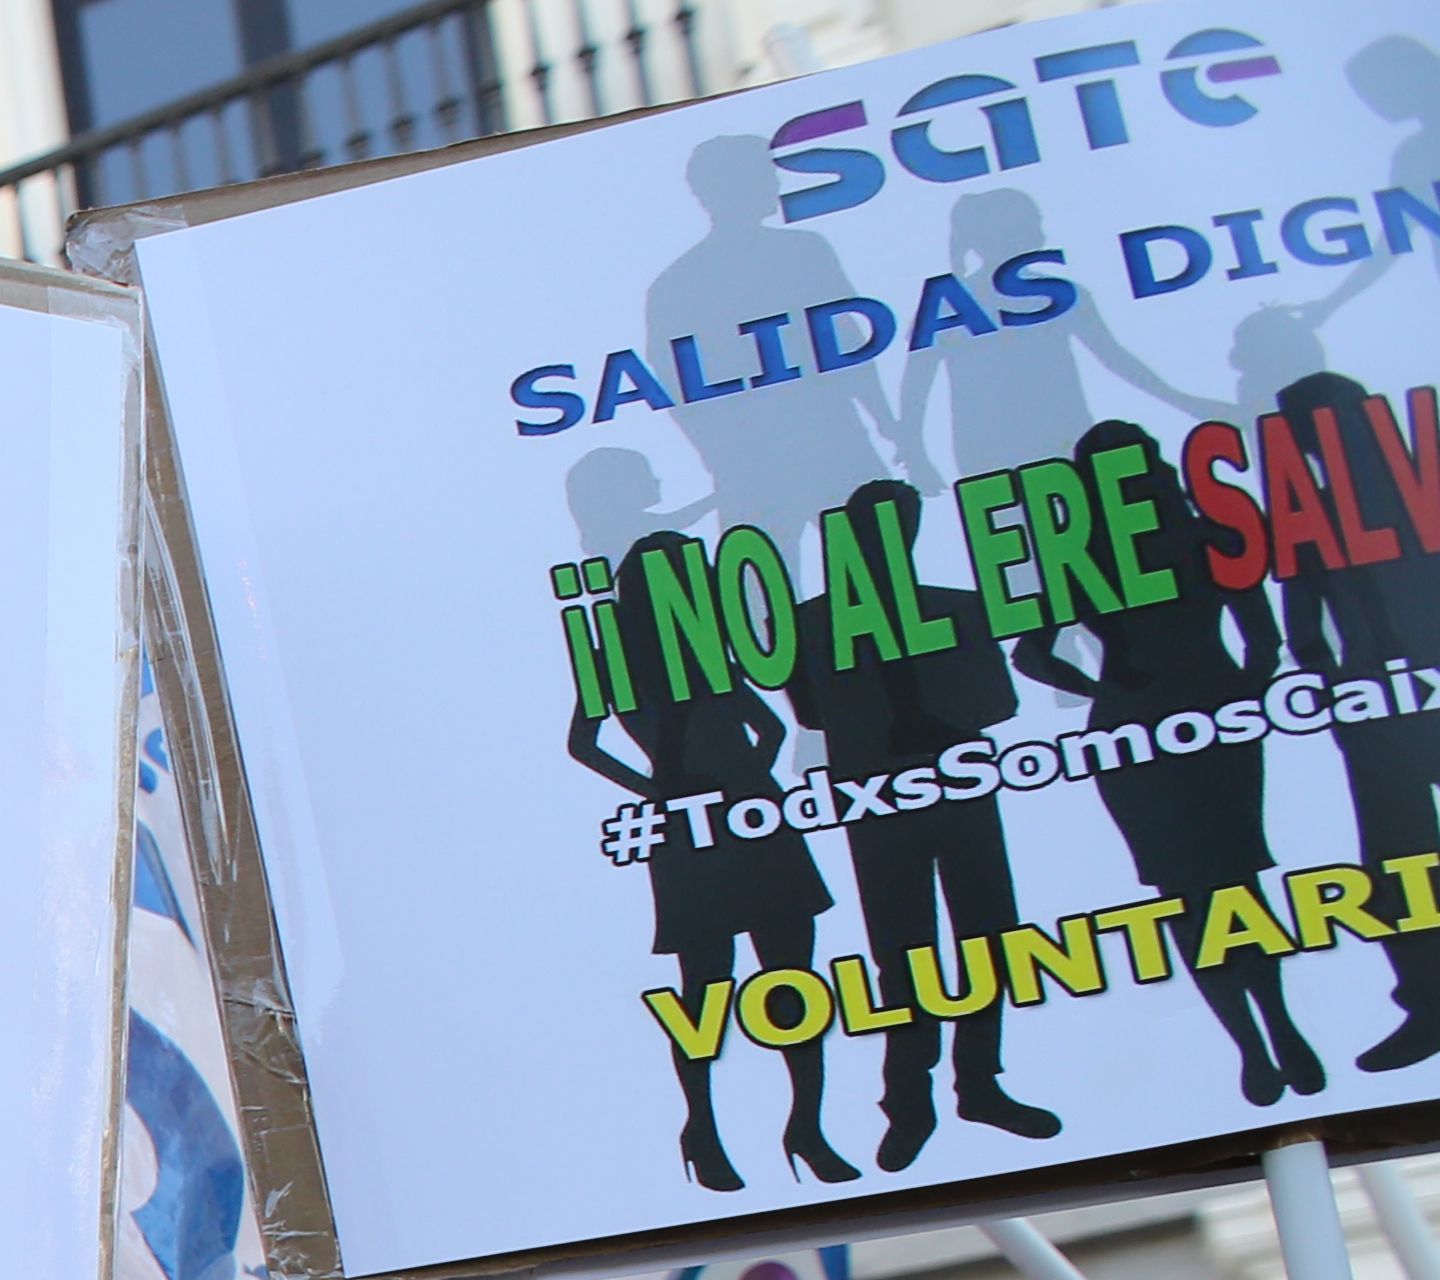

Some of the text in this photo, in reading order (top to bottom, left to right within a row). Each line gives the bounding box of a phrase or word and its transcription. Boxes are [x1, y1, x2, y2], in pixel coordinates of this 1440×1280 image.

[509, 249, 1078, 437] SALIDAS
[820, 498, 959, 674] AL
[954, 443, 1181, 642] ERE
